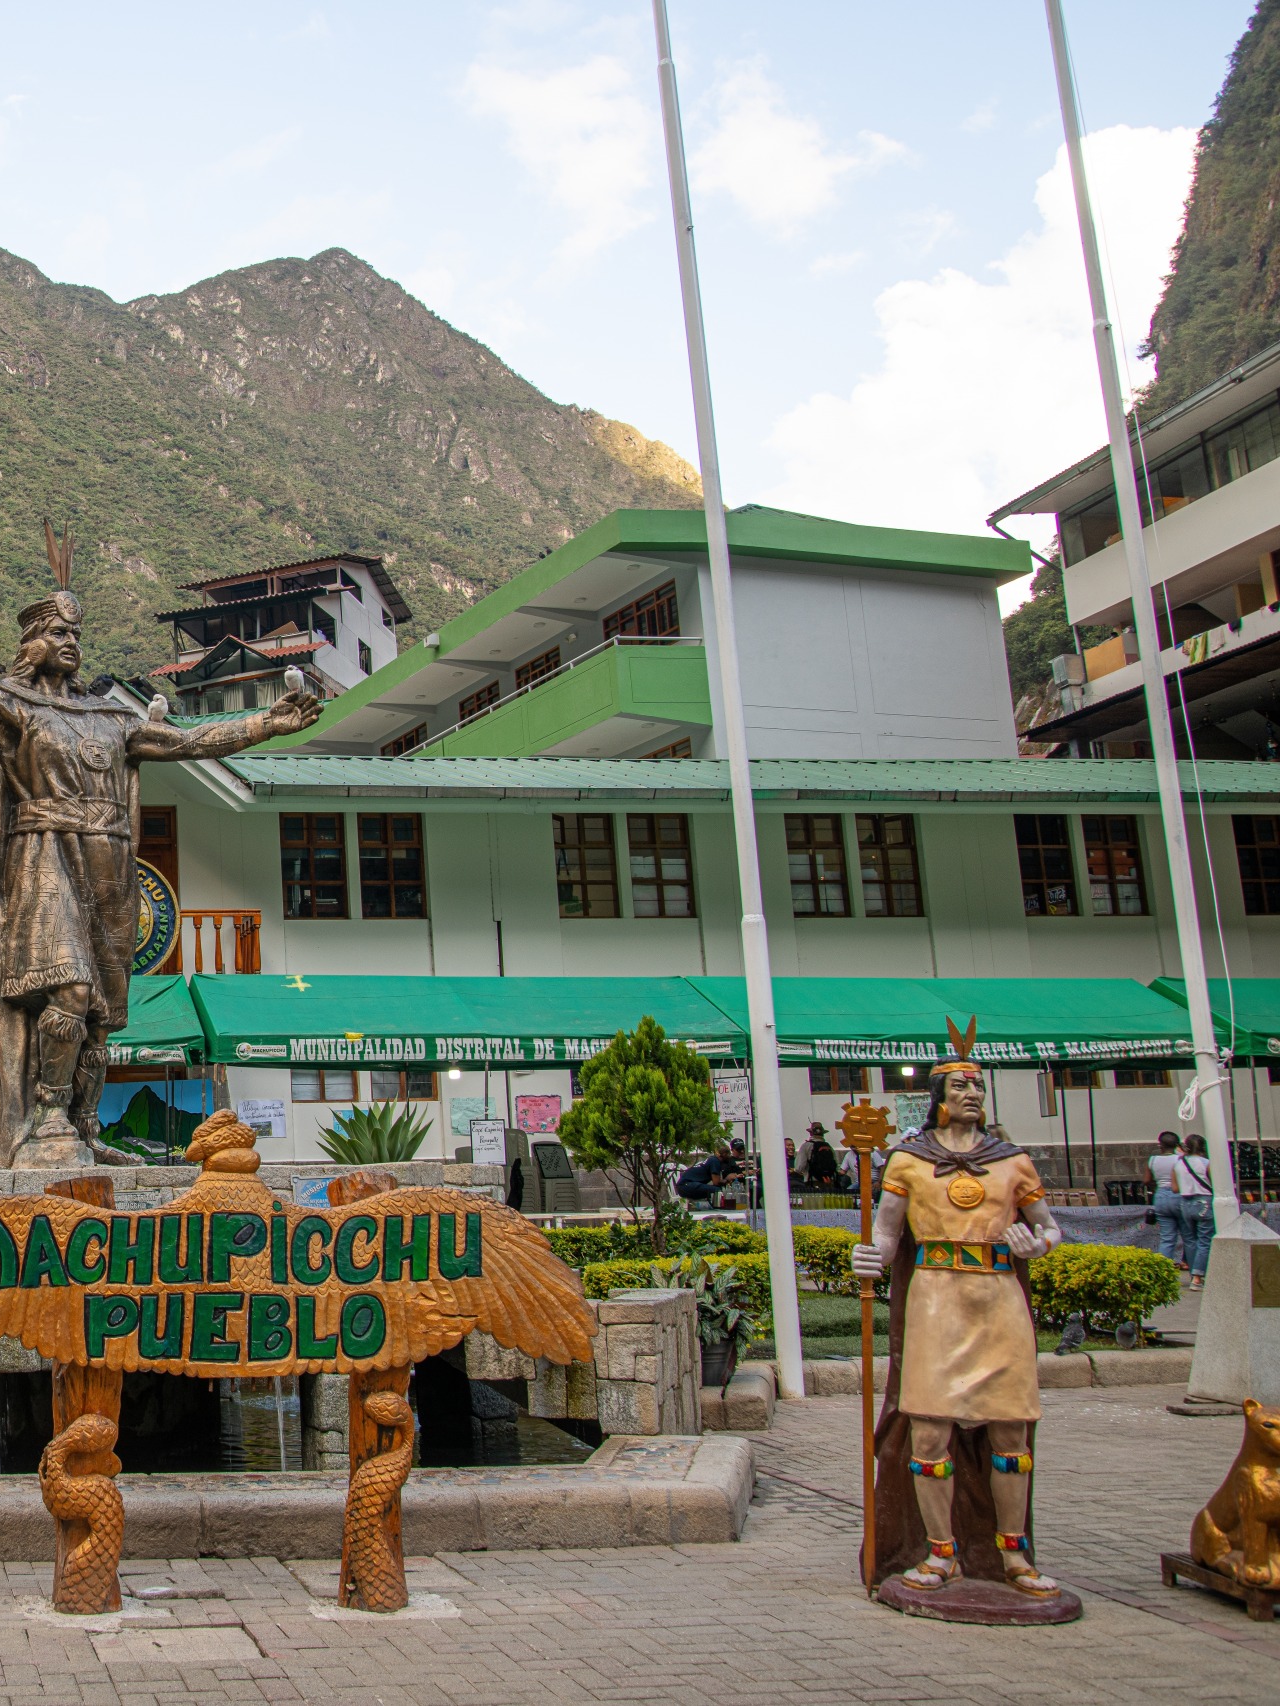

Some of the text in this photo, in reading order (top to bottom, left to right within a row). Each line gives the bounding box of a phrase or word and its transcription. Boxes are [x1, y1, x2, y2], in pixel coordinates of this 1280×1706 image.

[290, 1039, 426, 1061] MUNICIPALIDAD
[436, 1038, 524, 1060] DISTRITAL
[533, 1038, 556, 1060] DE
[814, 1039, 1172, 1061] MUNICIPALIDAD DTRITAL DE MACHUPICCHU
[84, 1293, 387, 1363] PUEBLO
